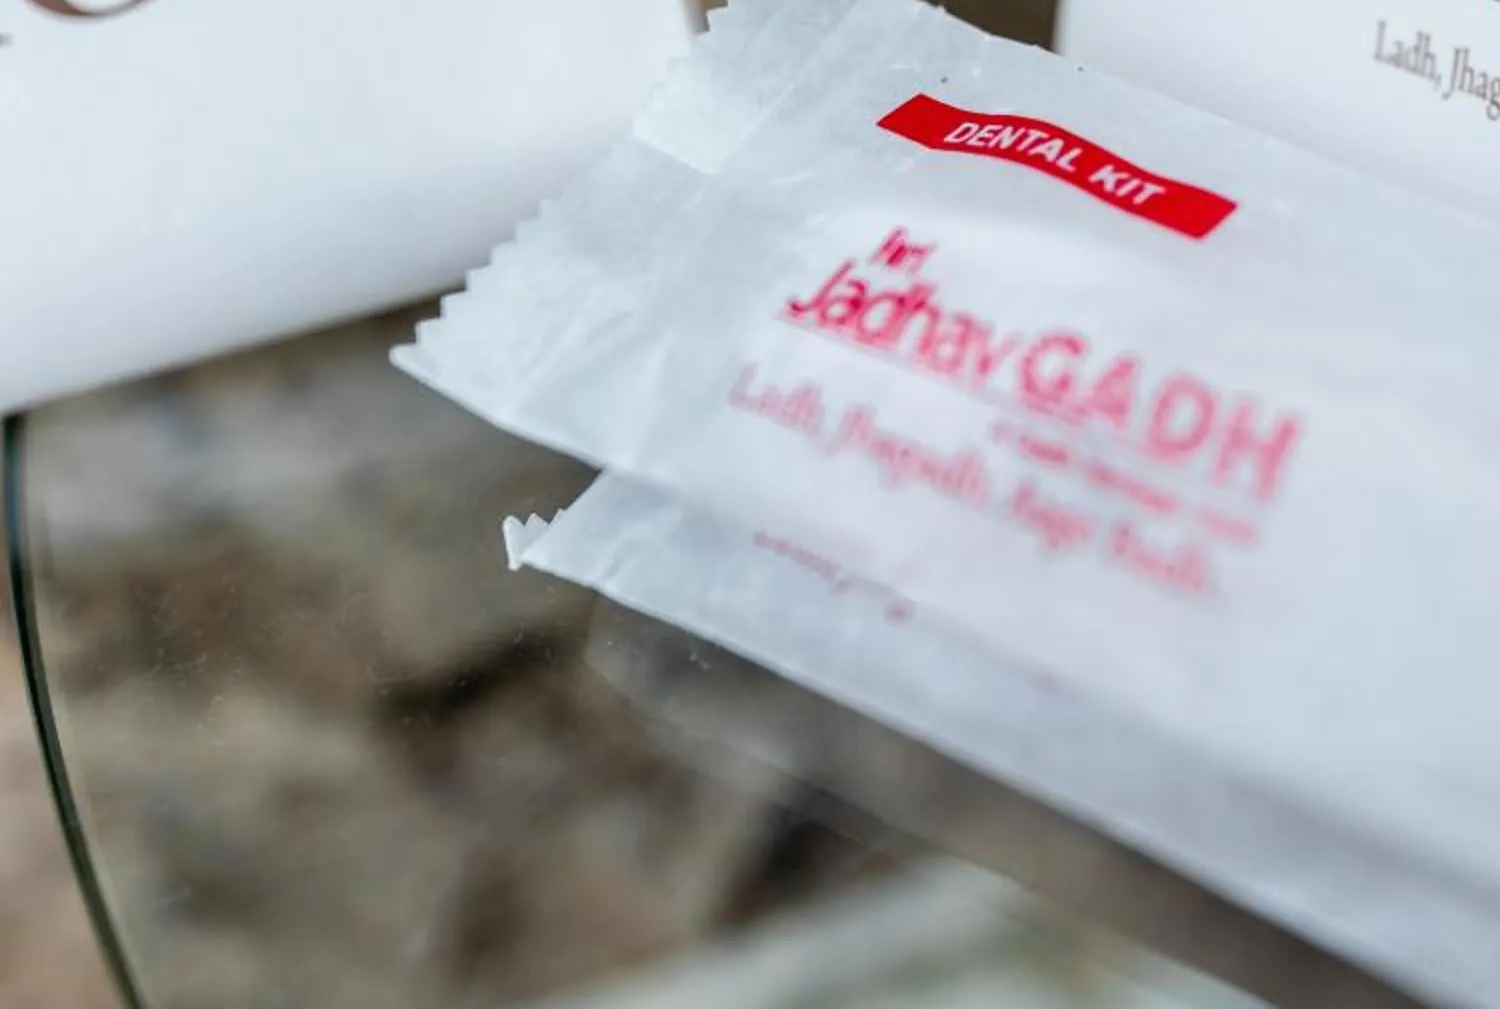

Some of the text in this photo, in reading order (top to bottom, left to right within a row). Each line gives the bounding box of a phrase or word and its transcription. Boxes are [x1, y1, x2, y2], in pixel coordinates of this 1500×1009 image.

[1373, 19, 1442, 92] Ladh,
[944, 120, 1167, 207] DENTAL KIT
